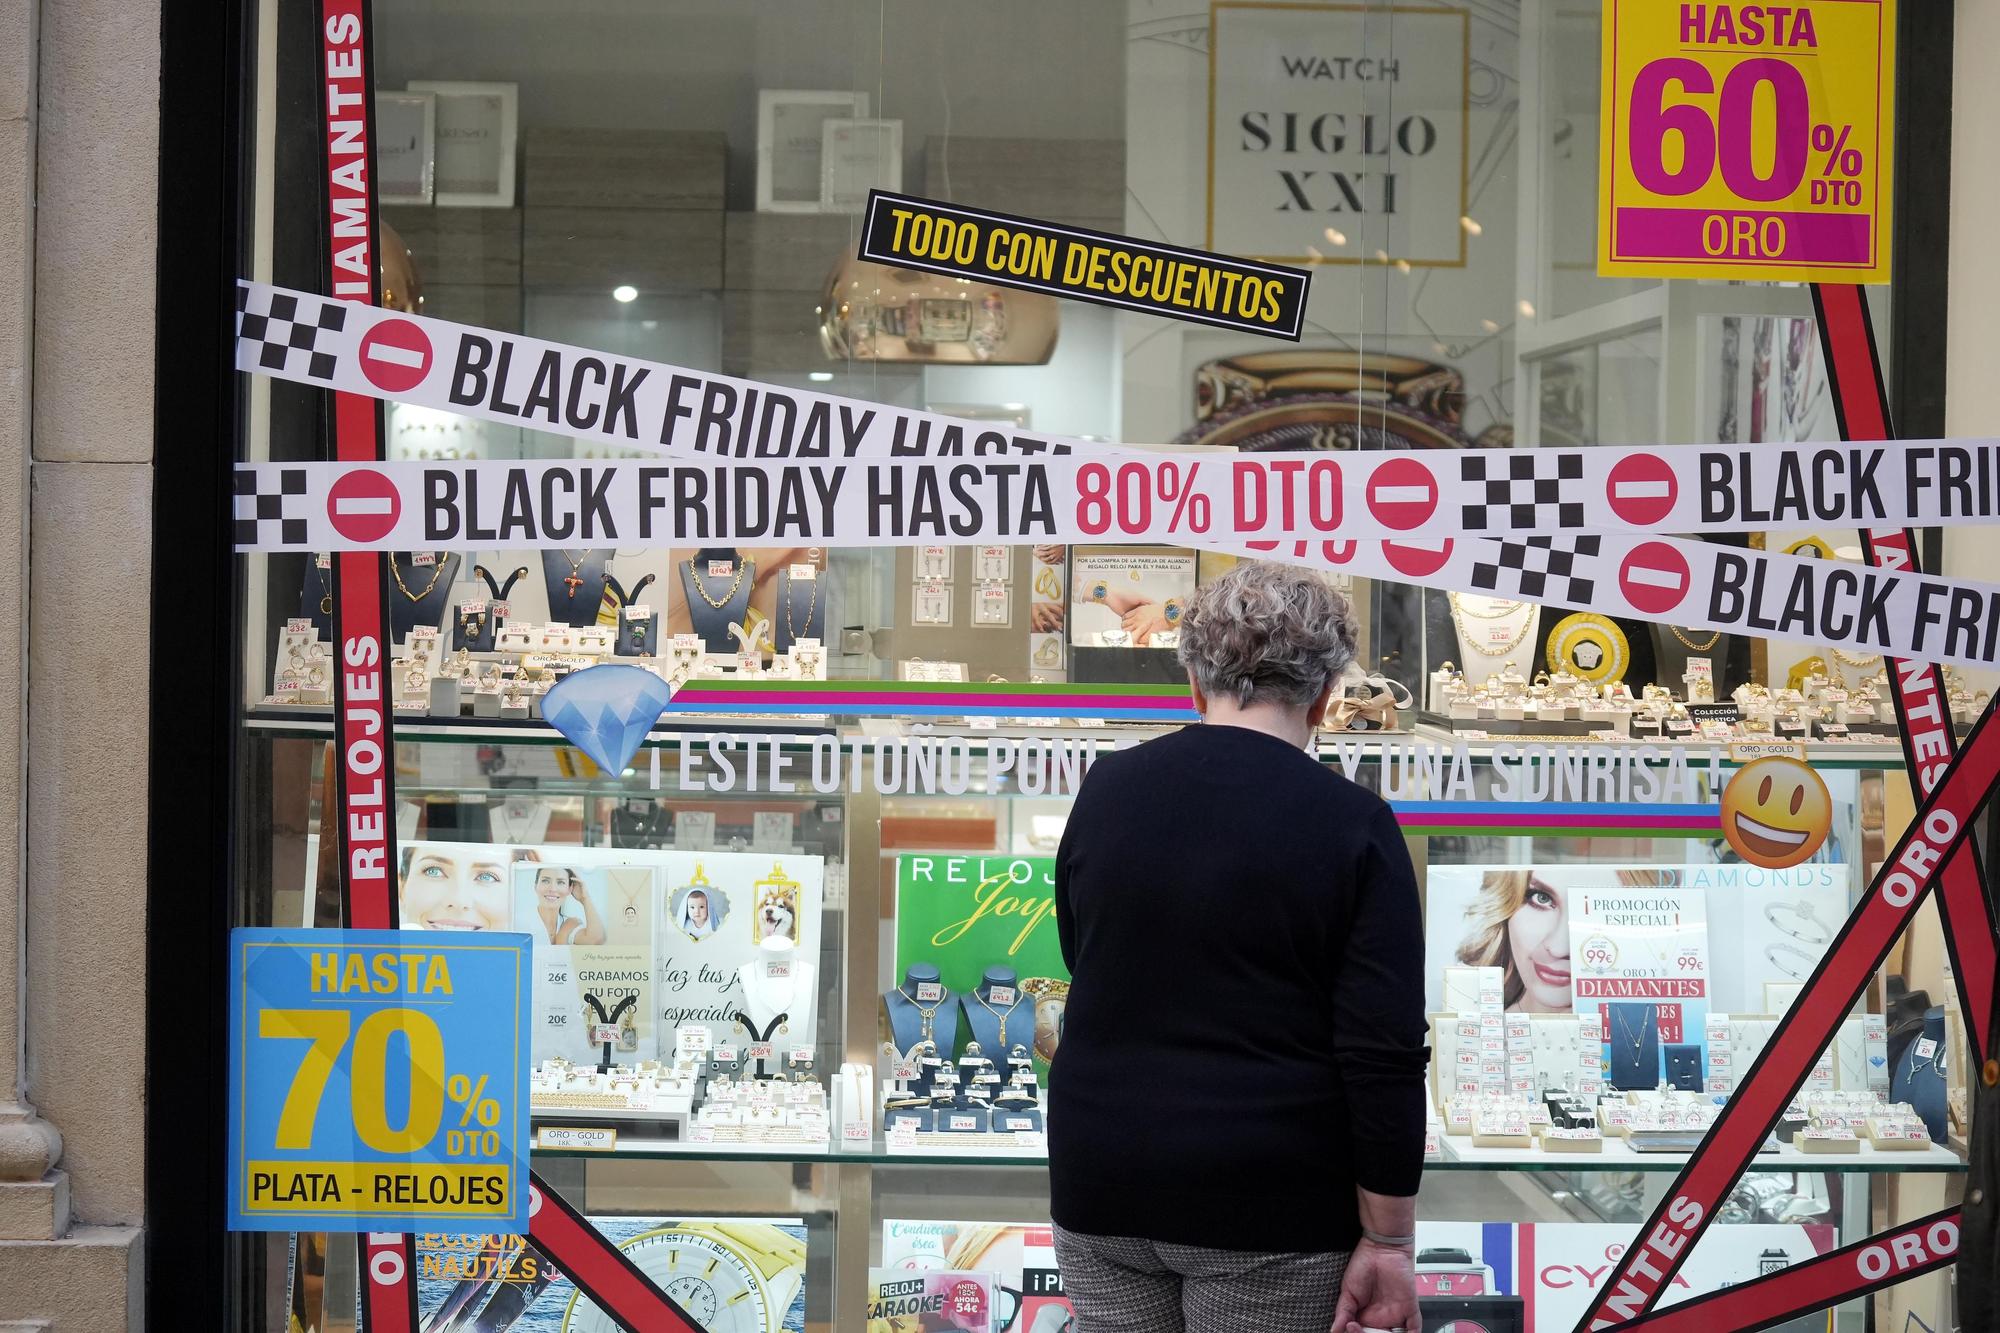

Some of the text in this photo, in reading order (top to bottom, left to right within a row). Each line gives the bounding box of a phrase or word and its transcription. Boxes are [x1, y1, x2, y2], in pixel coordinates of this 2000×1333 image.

[1680, 4, 1818, 47] HASTA
[1281, 55, 1400, 81] WATCH
[1241, 111, 1437, 156] SIGLO
[326, 13, 369, 303] IAMANTES
[1276, 170, 1397, 214] XXI
[1811, 180, 1862, 206] DTO
[1702, 215, 1787, 258] ORO
[890, 209, 1284, 323] TODO CON DESCUENTOS
[449, 332, 651, 440] BLACK
[1701, 449, 1888, 523] BLACK
[424, 459, 1344, 541] BLACK FRIDAY HASTA 80% DTO
[1707, 550, 1901, 650] BLACK
[560, 656, 586, 664] GOLD
[345, 634, 386, 881] RELOJES
[679, 732, 796, 792] ESTE
[812, 723, 970, 796] OTOÑO
[1335, 741, 1366, 782] Y
[1381, 740, 1476, 801] UNA
[1491, 742, 1692, 805] SONRISA
[1882, 808, 1958, 908] ORO
[1660, 867, 1833, 888] DIAMONDS
[931, 872, 1058, 956] Joy
[1594, 896, 1681, 912] PROMOCIÓN
[1605, 914, 1672, 926] ESPECIAL
[1586, 950, 1613, 964] 99€
[1678, 956, 1704, 971] 99€
[309, 953, 454, 995] HASTA
[548, 972, 568, 982] 26€
[578, 971, 649, 981] GRABAMOS
[1622, 968, 1657, 978] ORO Y
[587, 988, 640, 998] TU FOTO
[1580, 980, 1700, 996] DIAMANTES
[548, 1015, 567, 1024] 20€
[448, 1131, 500, 1158] DTO
[548, 1130, 570, 1139] ORO
[578, 1131, 605, 1140] GOLD
[253, 1174, 342, 1203] PLATA
[373, 1175, 504, 1206] RELOJES
[1856, 1220, 1960, 1280] ORO
[423, 1254, 538, 1279] NAUTILS
[880, 1281, 924, 1297] RELOJ+
[956, 1303, 978, 1313] 54€
